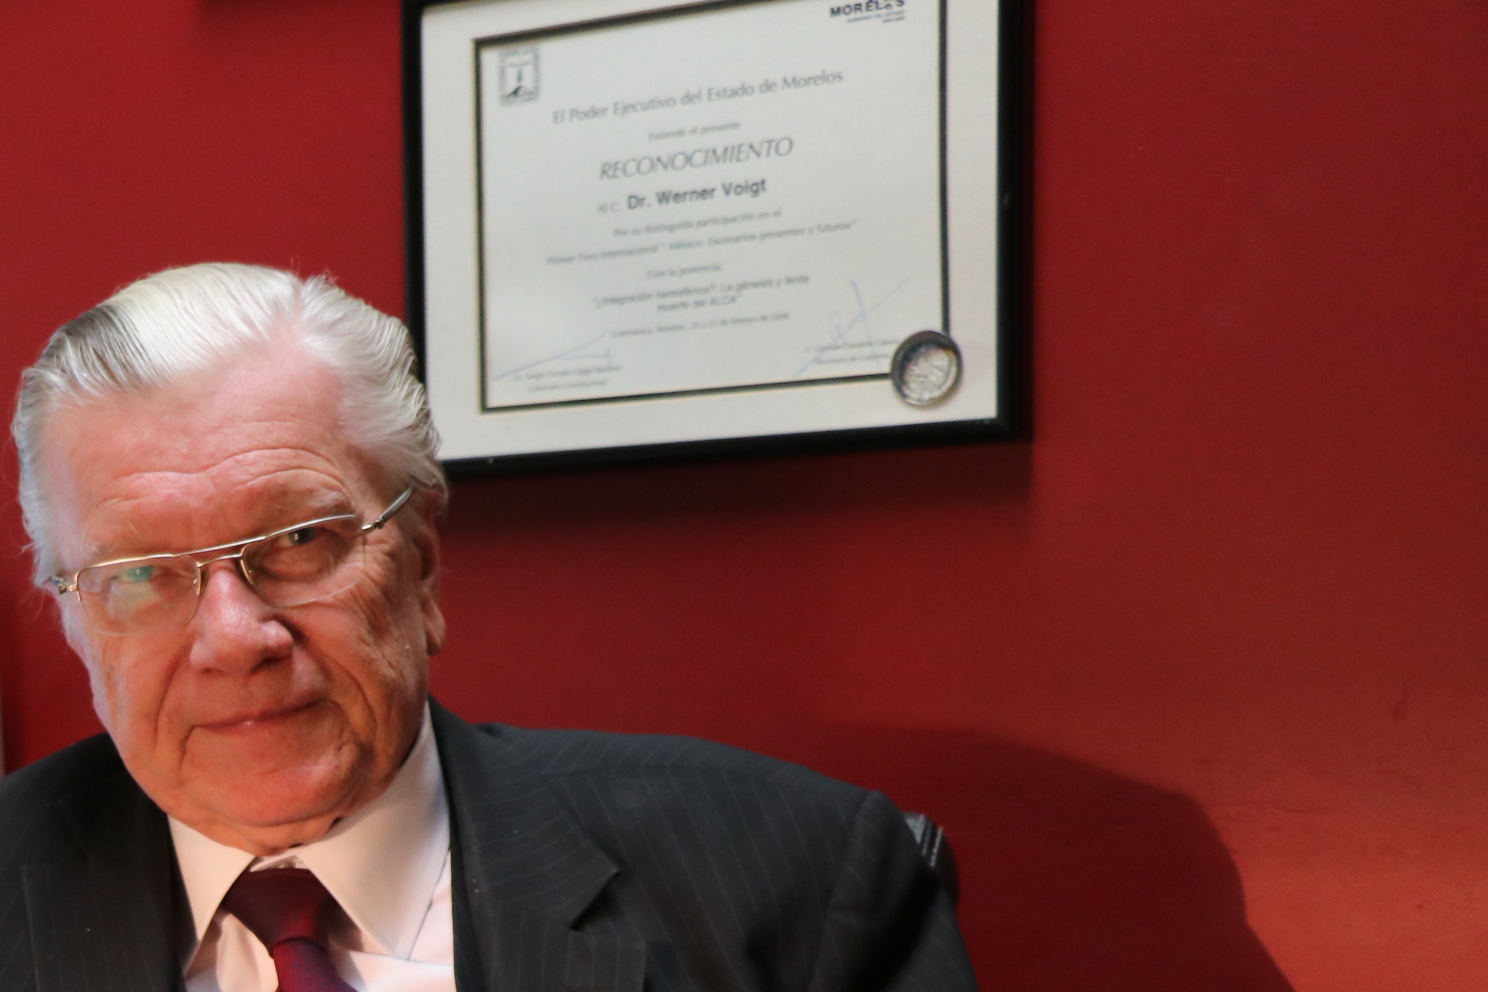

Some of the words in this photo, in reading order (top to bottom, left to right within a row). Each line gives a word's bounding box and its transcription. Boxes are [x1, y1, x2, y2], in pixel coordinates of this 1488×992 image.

[553, 109, 565, 125] El
[569, 103, 609, 122] Poder
[612, 96, 676, 119] Ejecutivo
[680, 89, 703, 107] del
[706, 83, 754, 102] Estado
[758, 79, 777, 94] de
[781, 70, 844, 90] Morelos
[598, 136, 795, 181] RECONOCIMIENTO
[627, 194, 651, 210] Dr.
[655, 184, 716, 206] Werner
[721, 178, 768, 198] Voigt
